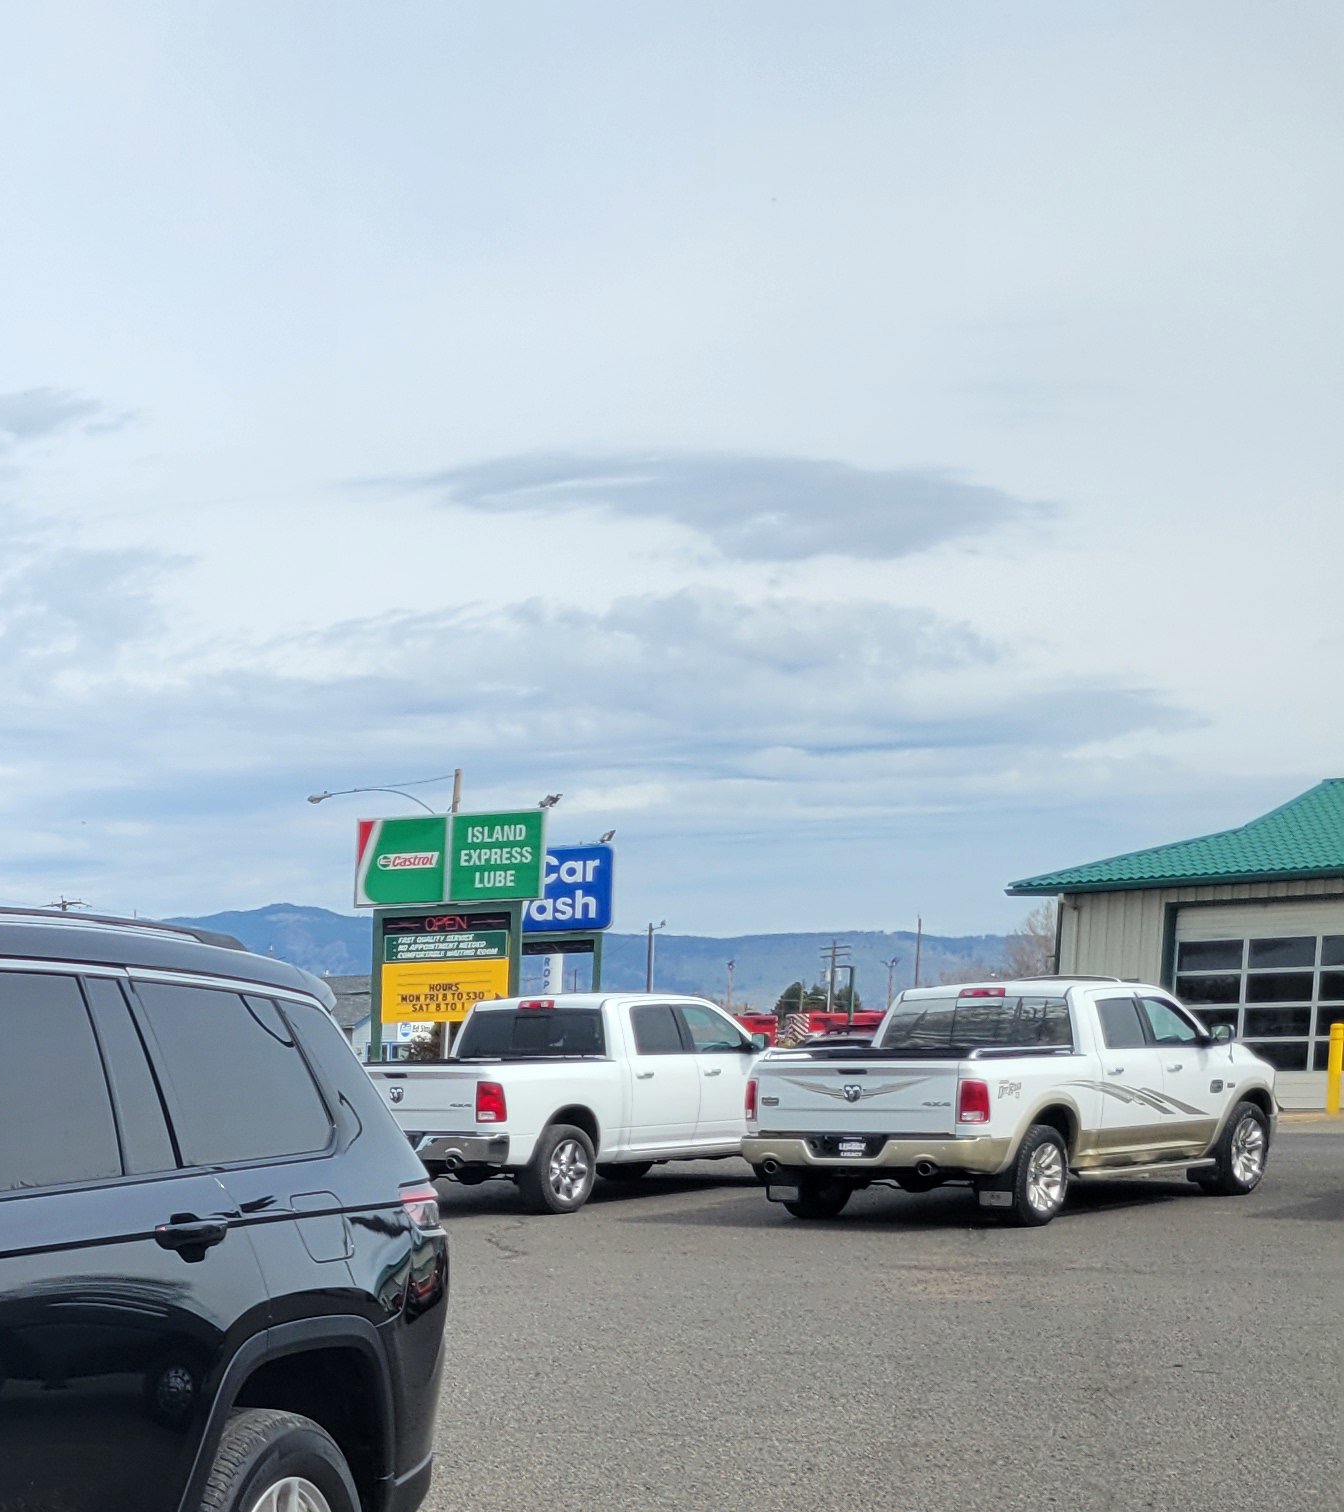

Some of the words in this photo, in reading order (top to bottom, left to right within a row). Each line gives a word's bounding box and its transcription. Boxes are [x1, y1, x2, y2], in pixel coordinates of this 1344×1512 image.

[467, 824, 527, 843] ISLAND
[392, 854, 434, 867] Castrol
[460, 846, 532, 866] EXPRESS
[544, 855, 600, 885] Car
[474, 870, 516, 888] LUBE
[425, 915, 468, 931] OPEN
[397, 936, 415, 944] FAST
[416, 935, 444, 943] QUALITY
[445, 934, 475, 942] SERVICE
[397, 944, 408, 952] NO
[409, 942, 458, 951] APPOINTMENT
[429, 983, 460, 992] HOURS
[400, 994, 421, 1003] MON
[424, 993, 439, 1002] FRI
[441, 992, 448, 1001] 8
[452, 992, 463, 1001] TO
[411, 1003, 430, 1013] SAT
[435, 1003, 441, 1012] 8
[445, 1002, 457, 1011] TO
